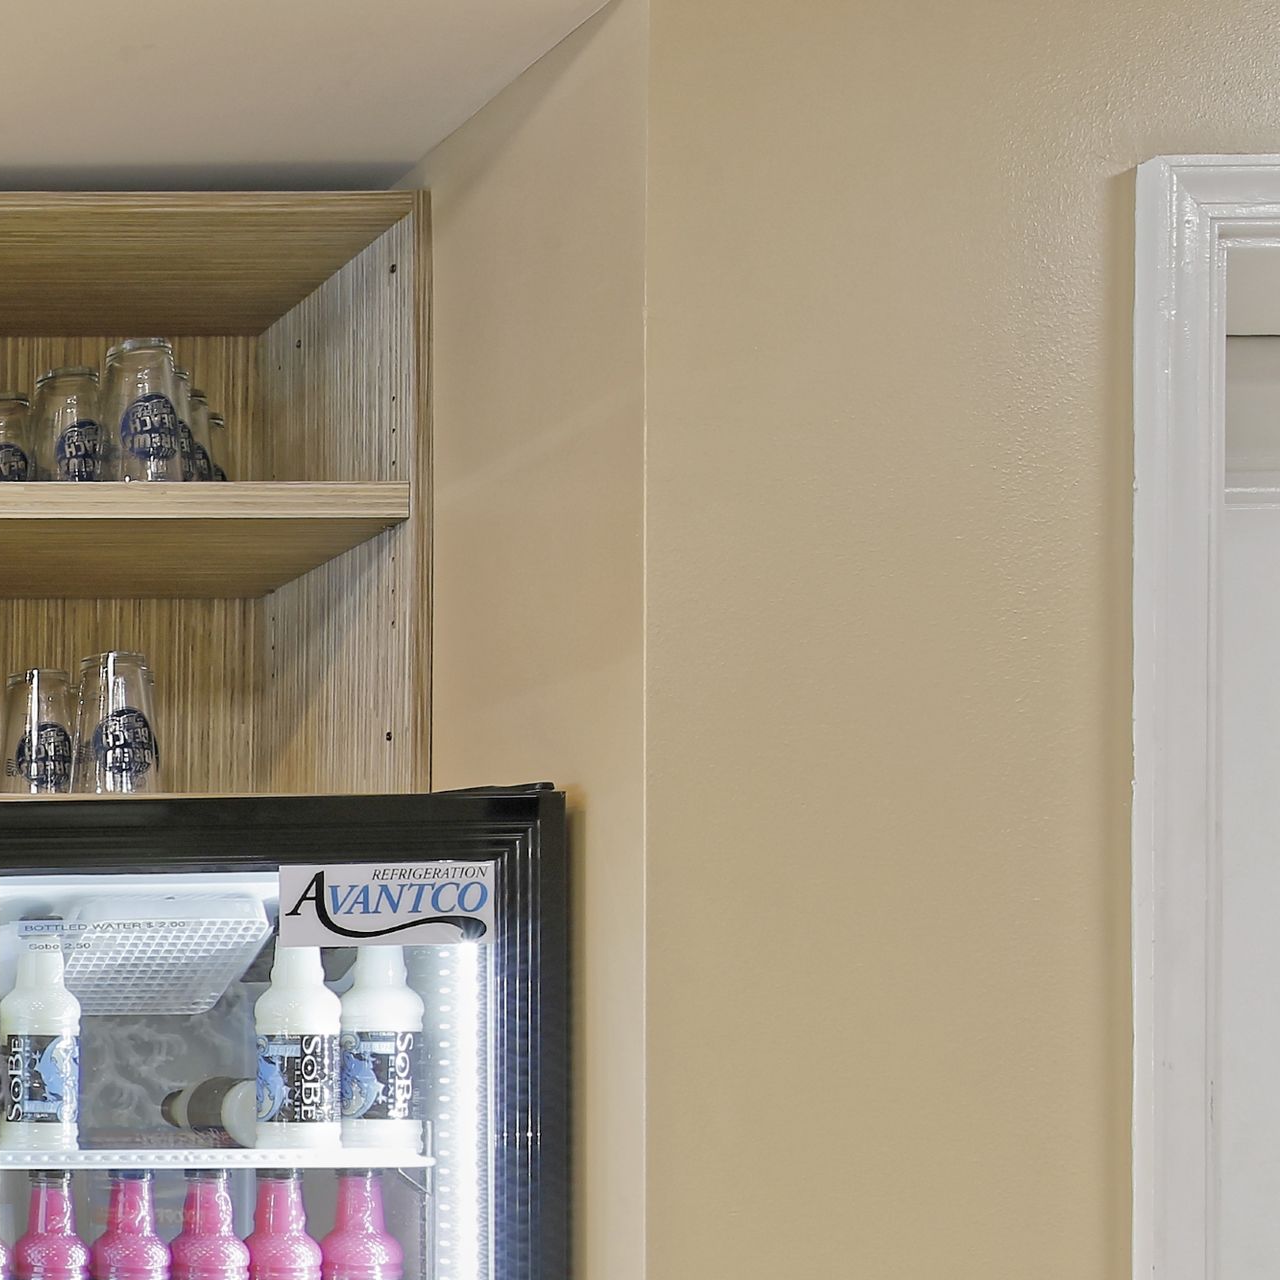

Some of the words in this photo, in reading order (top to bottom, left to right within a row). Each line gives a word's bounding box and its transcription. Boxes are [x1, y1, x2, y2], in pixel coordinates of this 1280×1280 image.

[372, 866, 489, 881] REFRIGERATION
[285, 870, 488, 920] AVANTCO
[24, 924, 88, 932] BOTTLED
[92, 922, 142, 931] WATER
[64, 942, 91, 950] 2.50
